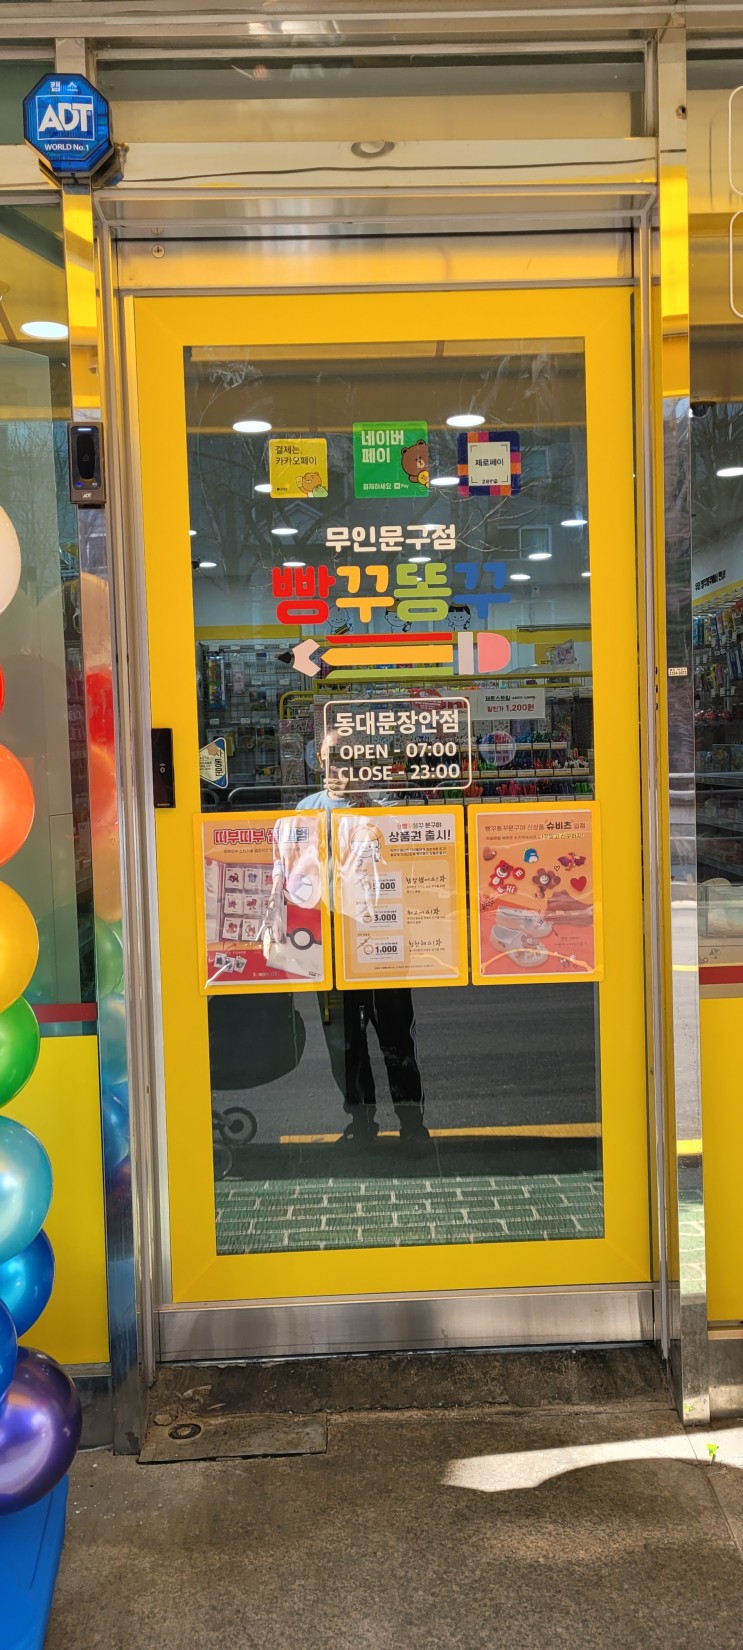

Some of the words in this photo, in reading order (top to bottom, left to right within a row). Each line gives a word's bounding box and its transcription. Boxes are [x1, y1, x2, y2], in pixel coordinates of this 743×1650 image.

[38, 102, 93, 132] ADT
[44, 143, 72, 151] WORLD
[73, 143, 90, 151] No.1
[361, 429, 405, 446] 네이버
[275, 456, 317, 466] 카카오페이
[361, 447, 391, 464] 페이
[474, 458, 504, 467] 제로페이
[362, 482, 392, 491] 결제하세요
[325, 523, 457, 553] 무인문구점
[271, 561, 513, 625] 빵꾸똥꾸
[506, 703, 535, 712] 1,200원
[333, 708, 460, 736] 동대문장안점
[339, 743, 389, 760] OPEN
[405, 742, 457, 758] 07:00
[337, 764, 393, 782] CLOSE
[410, 763, 460, 780] 23:00
[546, 821, 572, 831] 슈비츠
[213, 828, 265, 845] 띠부띠부
[388, 830, 422, 843] 상품권
[424, 829, 451, 841] 출시!
